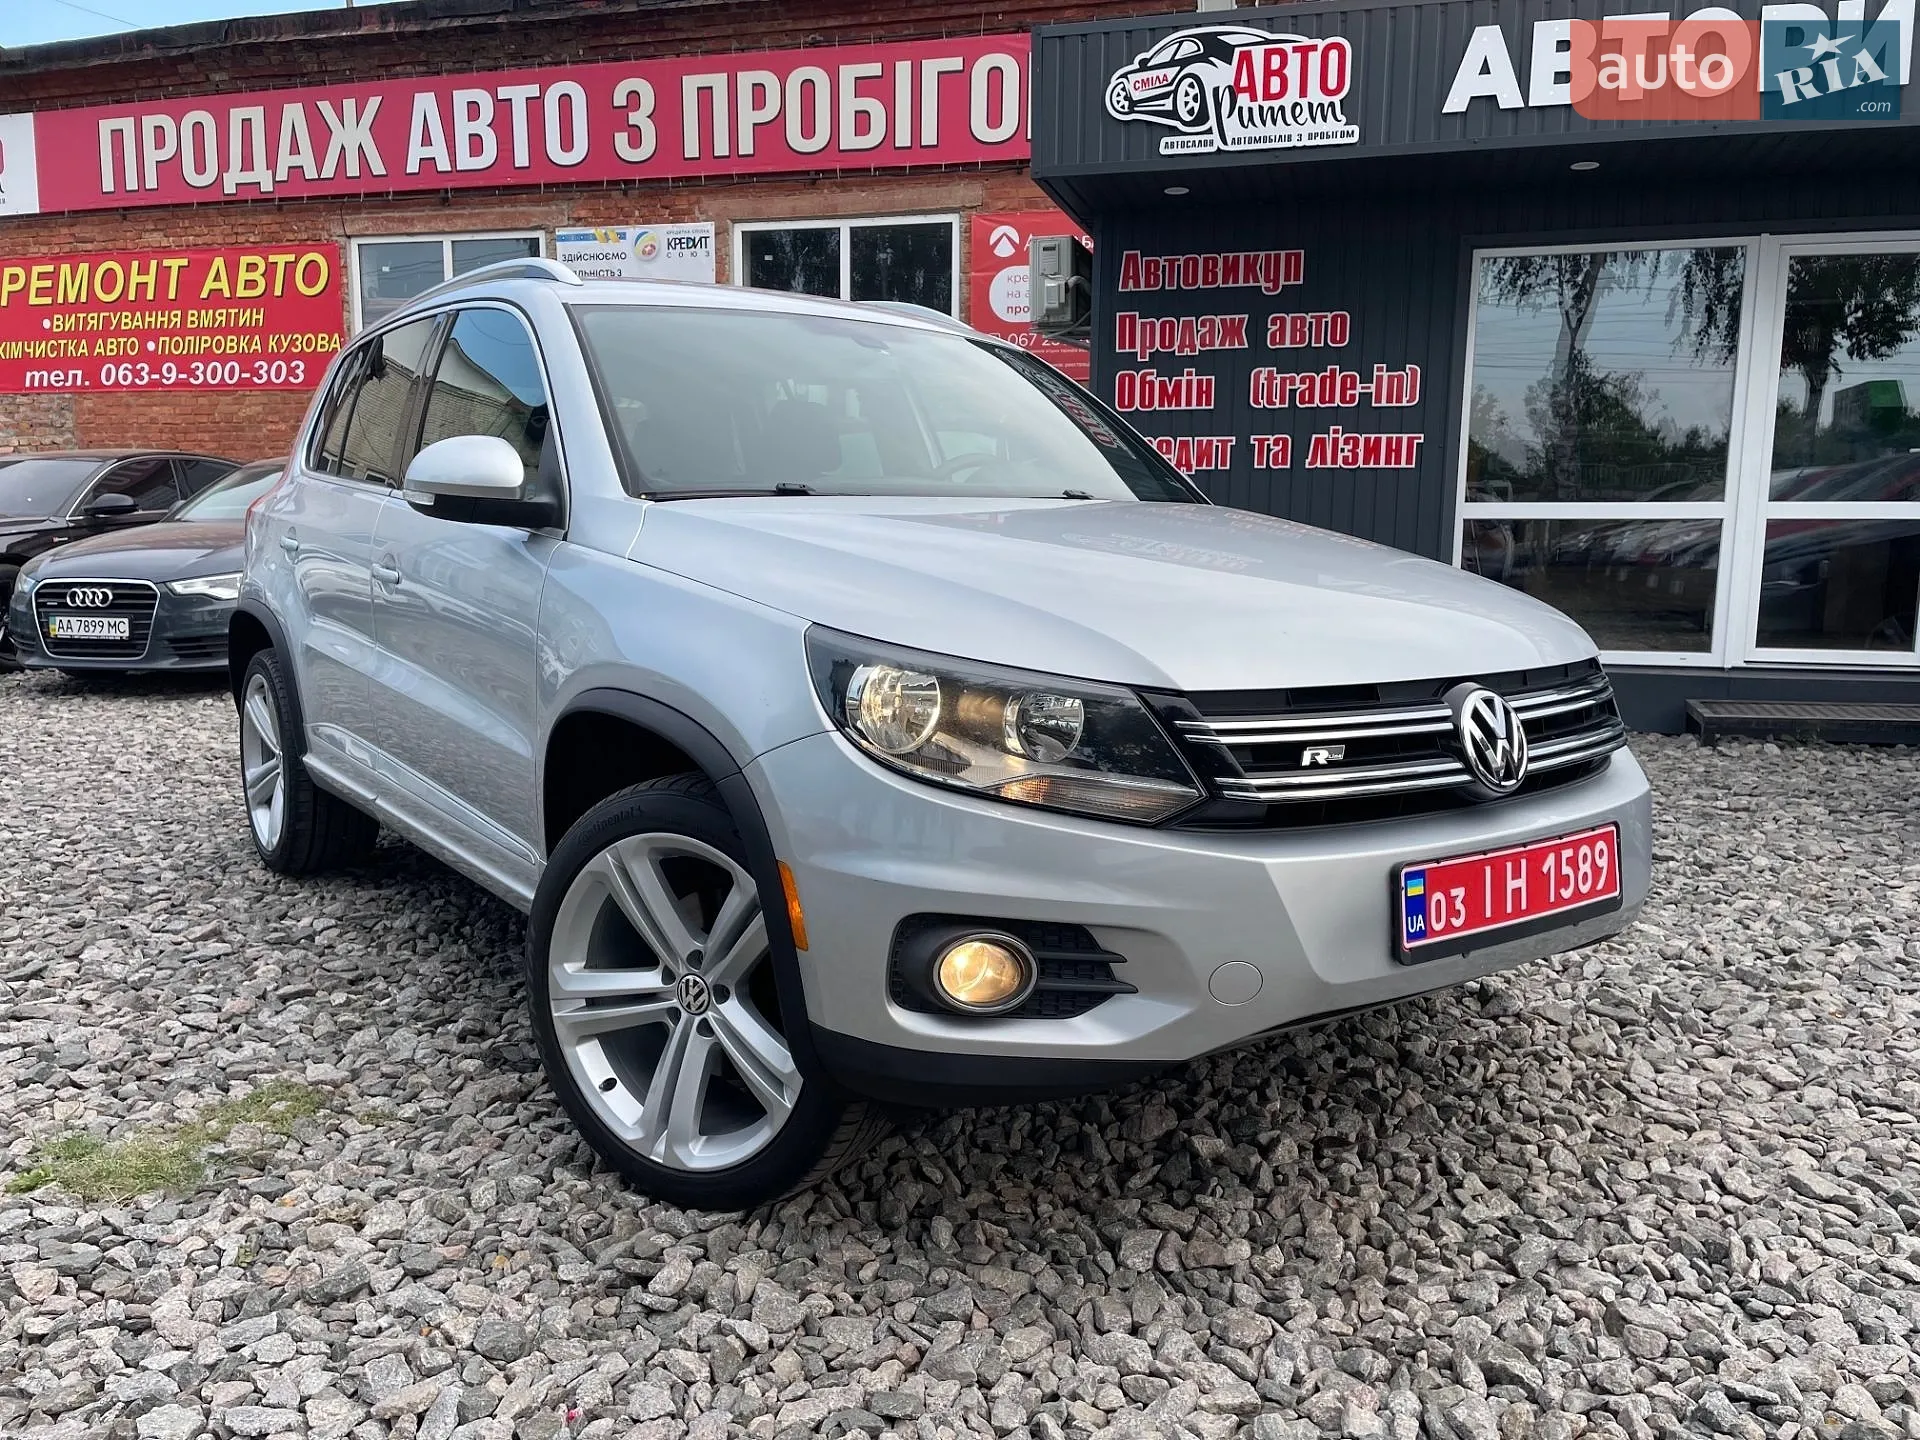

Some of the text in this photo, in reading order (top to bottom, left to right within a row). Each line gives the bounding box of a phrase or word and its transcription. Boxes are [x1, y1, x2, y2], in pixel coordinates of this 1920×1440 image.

[1133, 72, 1169, 93] СМІЛА
[1233, 41, 1347, 102] АВТО
[98, 95, 389, 197] ПРОДАЖ
[406, 80, 589, 175] АВТО
[681, 52, 1031, 160] ПРОБІГО
[1164, 138, 1214, 151] АВТОСАЛОН
[1230, 134, 1293, 146] АВТОМОБІЛІВ
[1307, 130, 1355, 142] ПРОБІГОМ
[0, 252, 329, 307] РЕМОНТ АВТО
[1118, 250, 1305, 295] Автовикуп
[53, 308, 264, 332] ВИТЯГУВАННЯ ВМЯТИН
[1116, 312, 1350, 361] Продаж авто
[93, 336, 139, 356] АВТО
[158, 334, 262, 355] ПОЛІРОВКА
[268, 332, 342, 354] КУЗОВА
[24, 360, 306, 388] тел. 063-9-300-303
[1116, 364, 1420, 411] Обмін (trade-in)
[1145, 425, 1424, 474] едит та лізинг
[58, 619, 126, 634] AA 7899 MC
[1430, 887, 1466, 932] 03
[1541, 840, 1609, 903] 1589
[1407, 914, 1425, 933] UA
